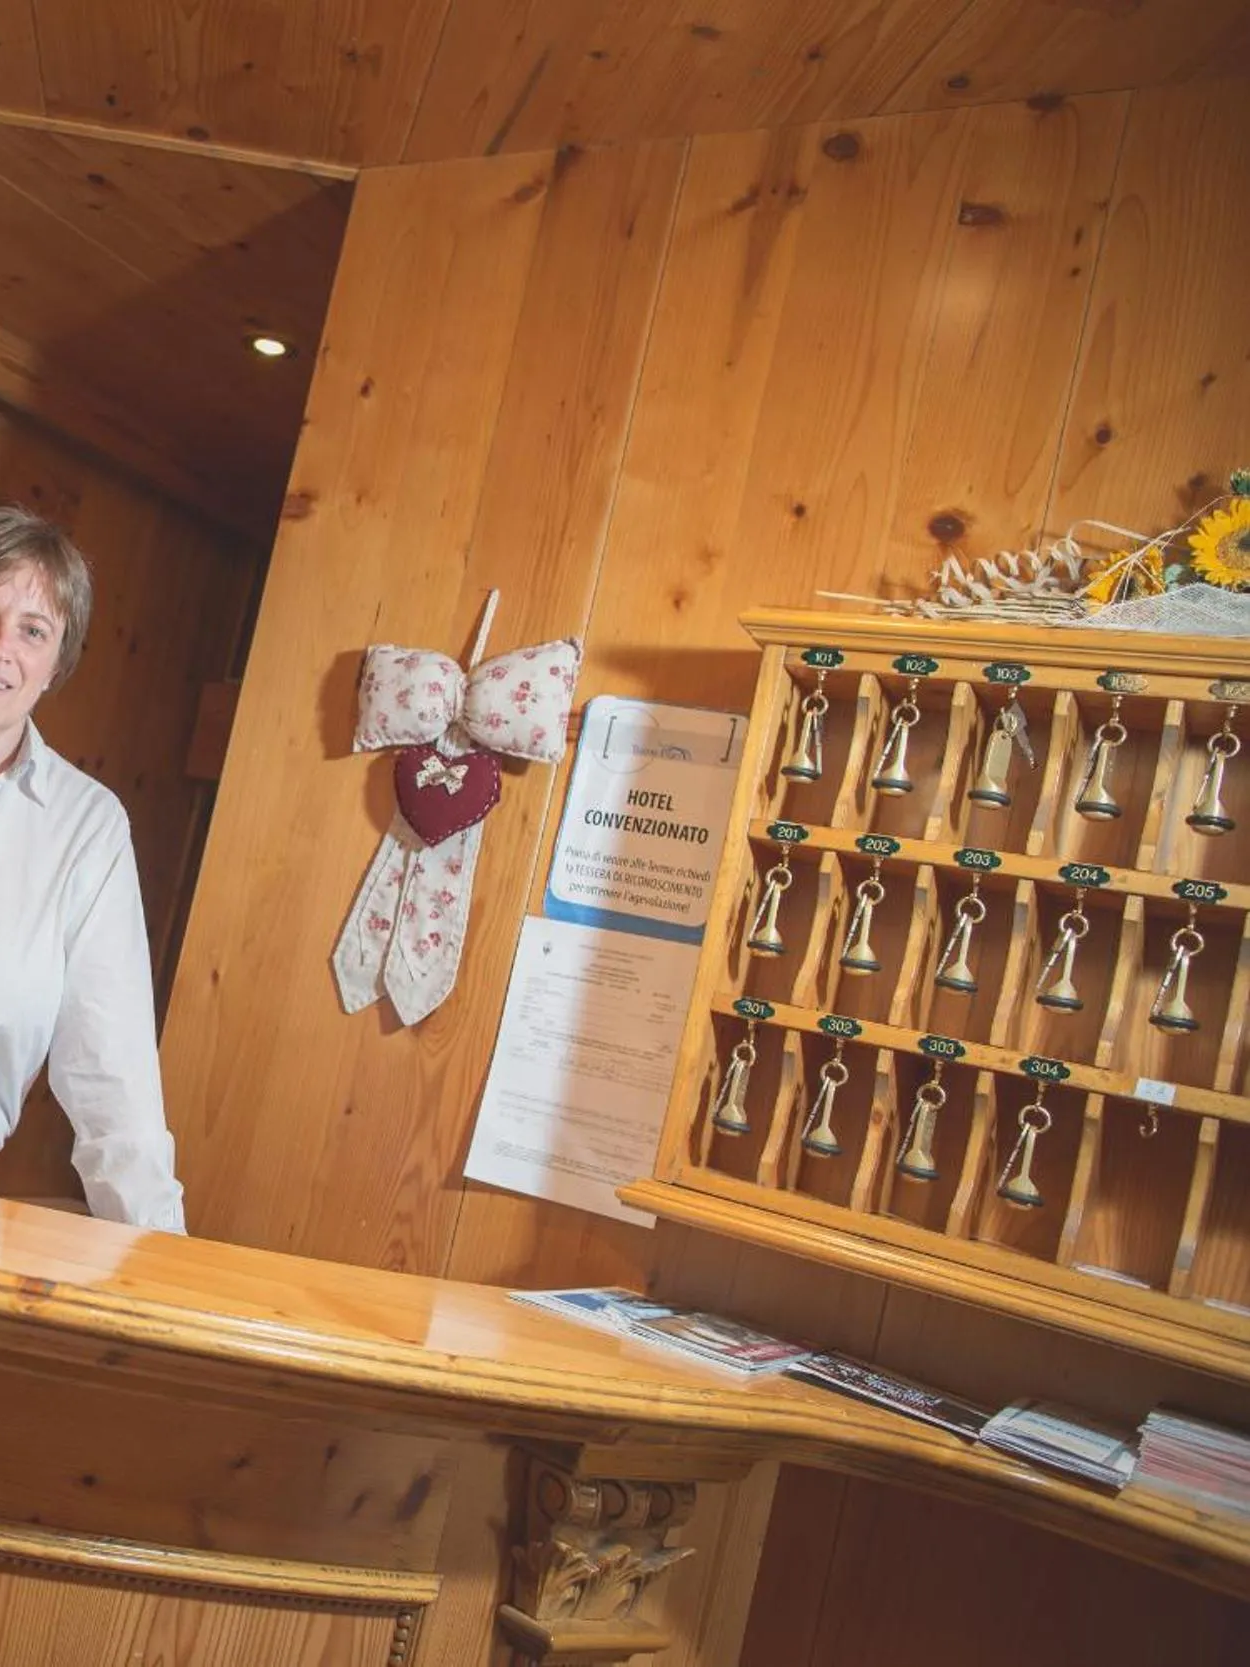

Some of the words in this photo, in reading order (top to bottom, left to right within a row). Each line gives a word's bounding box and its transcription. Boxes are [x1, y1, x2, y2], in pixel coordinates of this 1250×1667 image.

[815, 652, 833, 664] 101
[905, 659, 928, 673] 102
[996, 667, 1020, 681] 103
[627, 789, 675, 812] HOTEL
[584, 808, 710, 845] CONVENZIONATO
[777, 826, 798, 839] 201
[865, 838, 890, 852] 202
[964, 851, 991, 866] 203
[575, 864, 611, 881] TESSERA
[612, 869, 623, 882] DI
[624, 872, 703, 898] RICONOSCIMENTO
[1070, 866, 1099, 881] 204
[1184, 882, 1215, 899] 205
[741, 1000, 766, 1015] 301
[828, 1019, 853, 1034] 302
[929, 1039, 955, 1055] 303
[1031, 1060, 1059, 1076] 304
